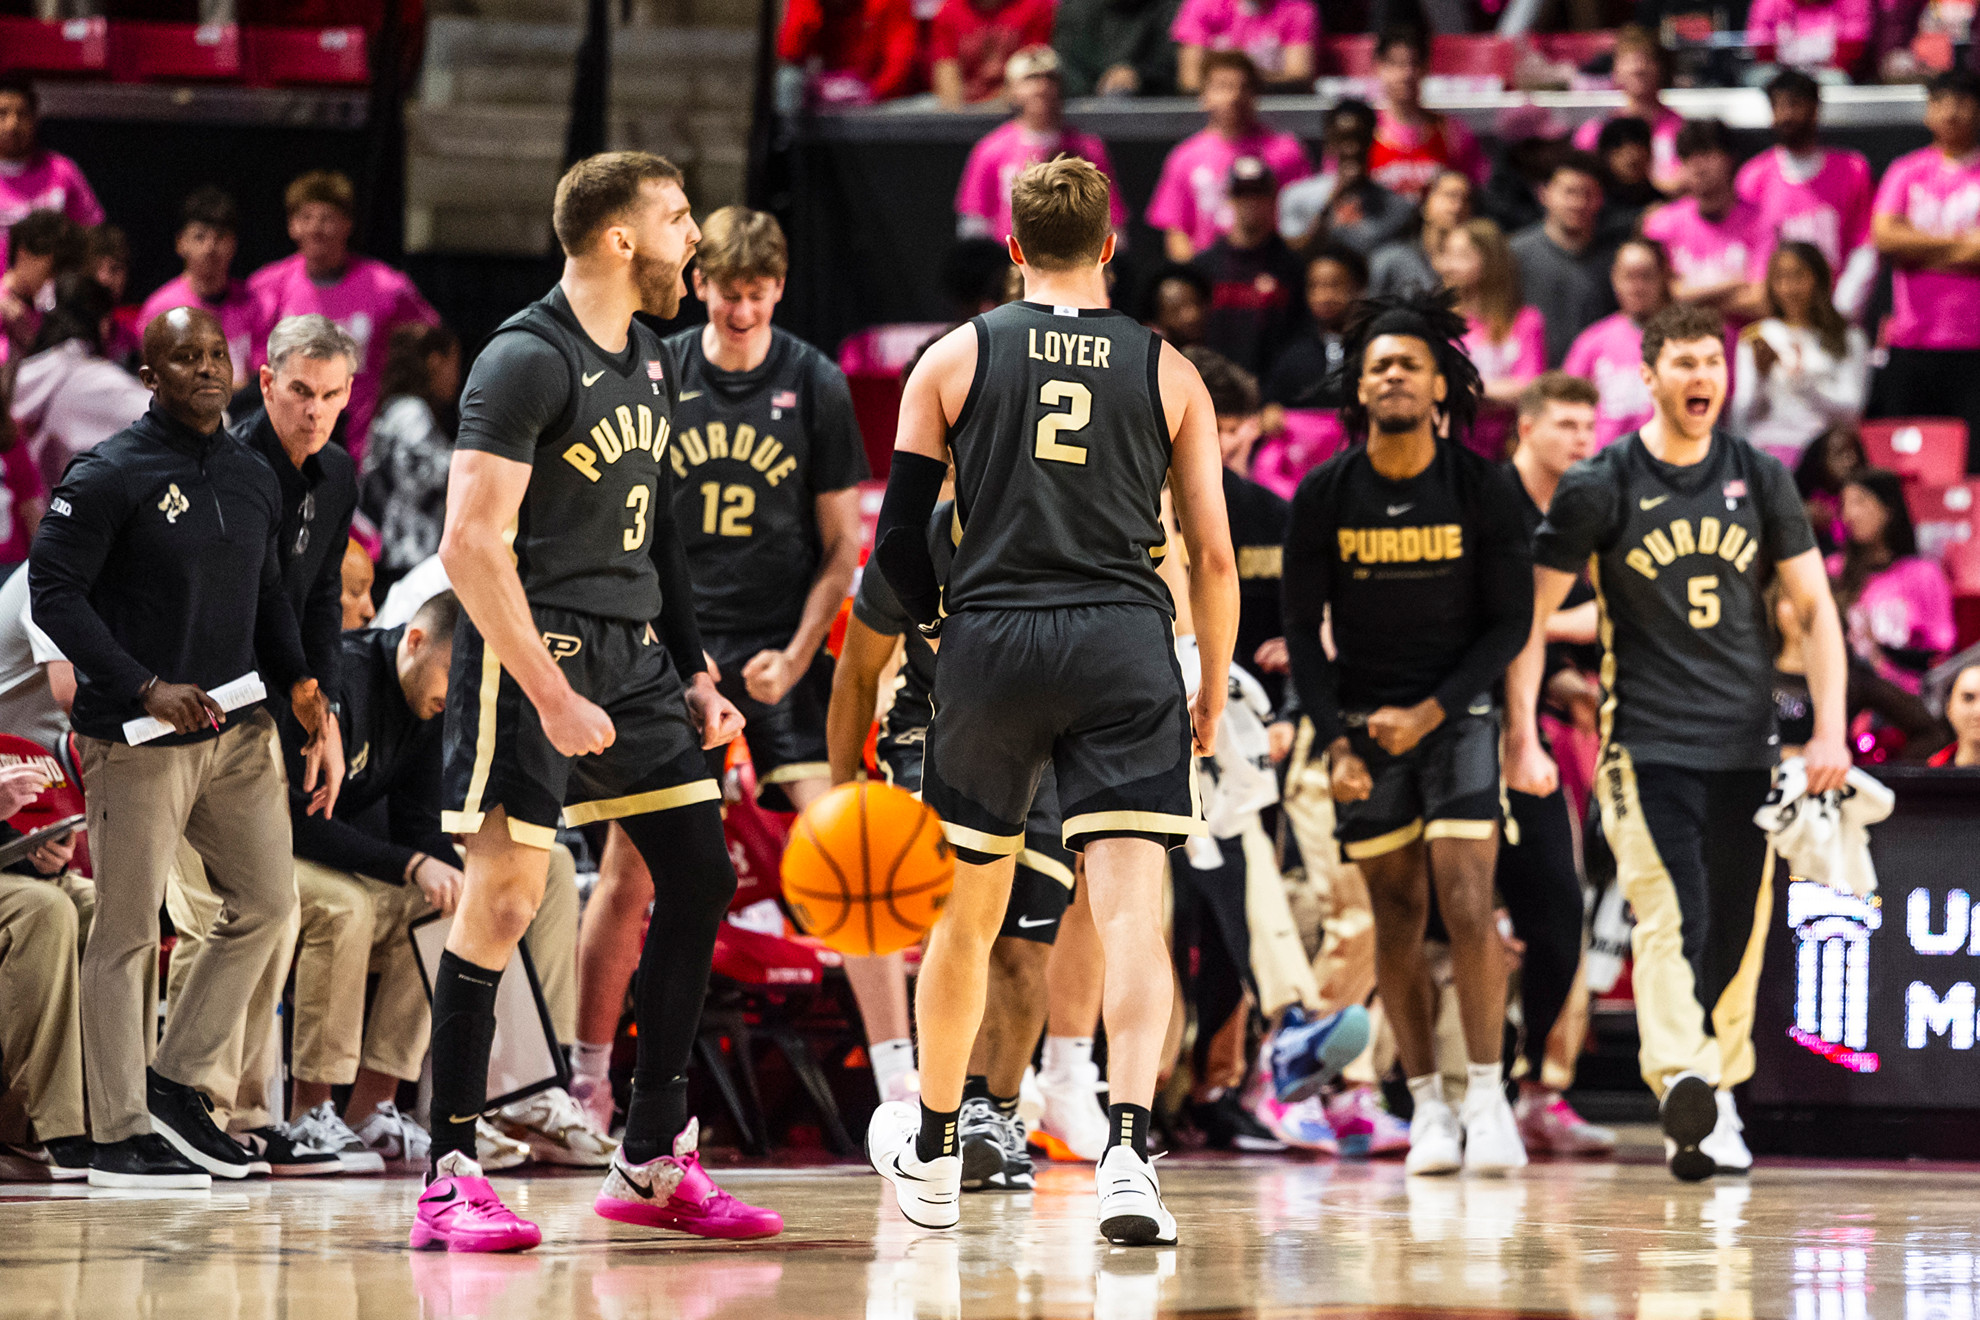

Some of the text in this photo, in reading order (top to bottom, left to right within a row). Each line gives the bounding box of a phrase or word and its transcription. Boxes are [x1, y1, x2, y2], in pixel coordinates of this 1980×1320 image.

[1029, 328, 1111, 369] LOYER
[1035, 379, 1092, 465] 2
[670, 421, 797, 487] PURDUE
[623, 484, 650, 551] 3
[701, 481, 756, 536] 12
[1337, 523, 1463, 564] PURDUE
[1687, 575, 1721, 629] 5
[1905, 979, 1980, 1051] M
